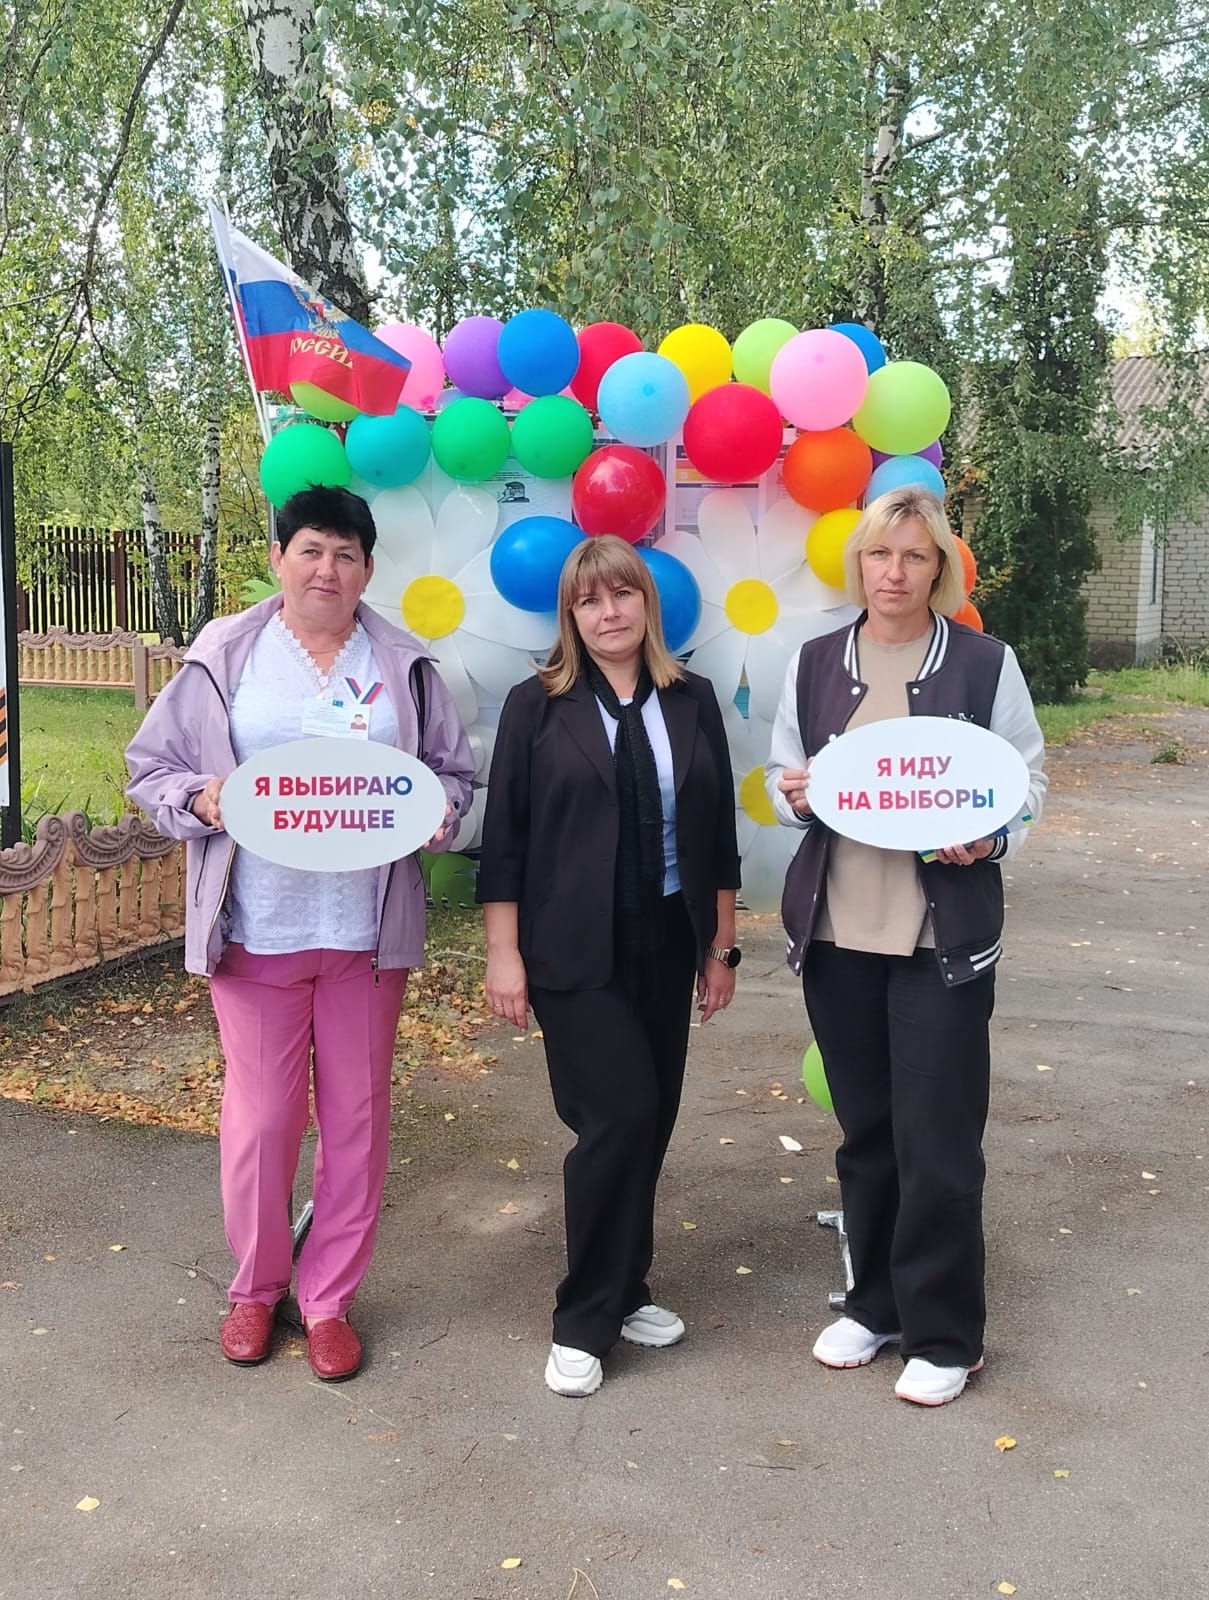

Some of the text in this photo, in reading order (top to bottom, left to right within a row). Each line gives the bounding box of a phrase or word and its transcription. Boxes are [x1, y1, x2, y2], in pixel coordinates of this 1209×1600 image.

[289, 337, 354, 369] ОССИ
[877, 756, 952, 779] Я ИДУ
[255, 776, 413, 796] Я ВЫБИРАЮ
[838, 788, 994, 810] НА ВЫБОРЫ
[274, 810, 394, 832] БУДУЩЕЕ
